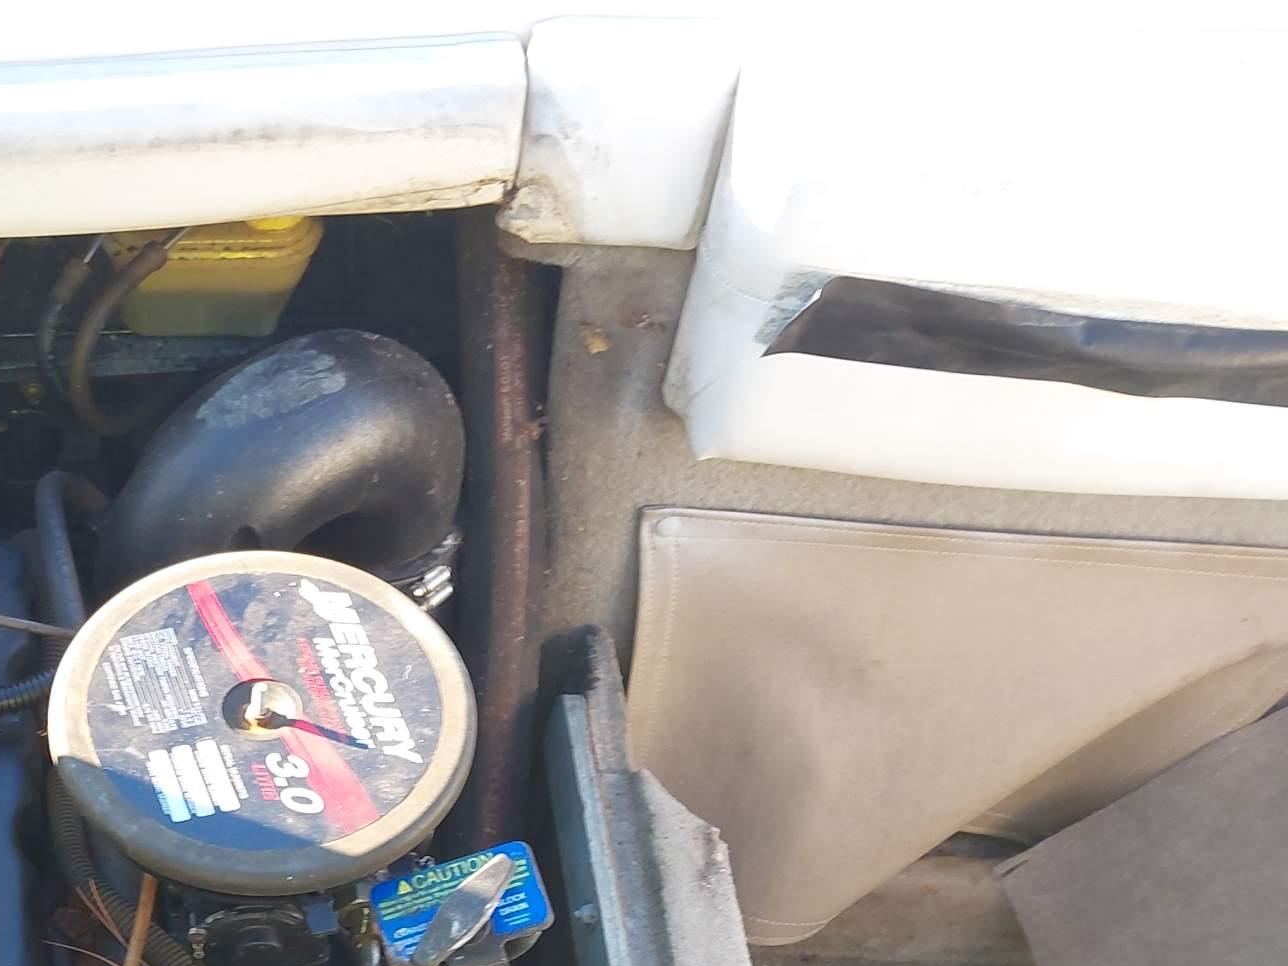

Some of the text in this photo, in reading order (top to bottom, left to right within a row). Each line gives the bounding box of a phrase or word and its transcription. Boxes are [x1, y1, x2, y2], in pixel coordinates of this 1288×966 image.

[298, 578, 424, 765] MERCURY
[312, 636, 376, 751] MerCruiser
[263, 750, 325, 815] 3.0
[411, 852, 495, 890] CAUTION
